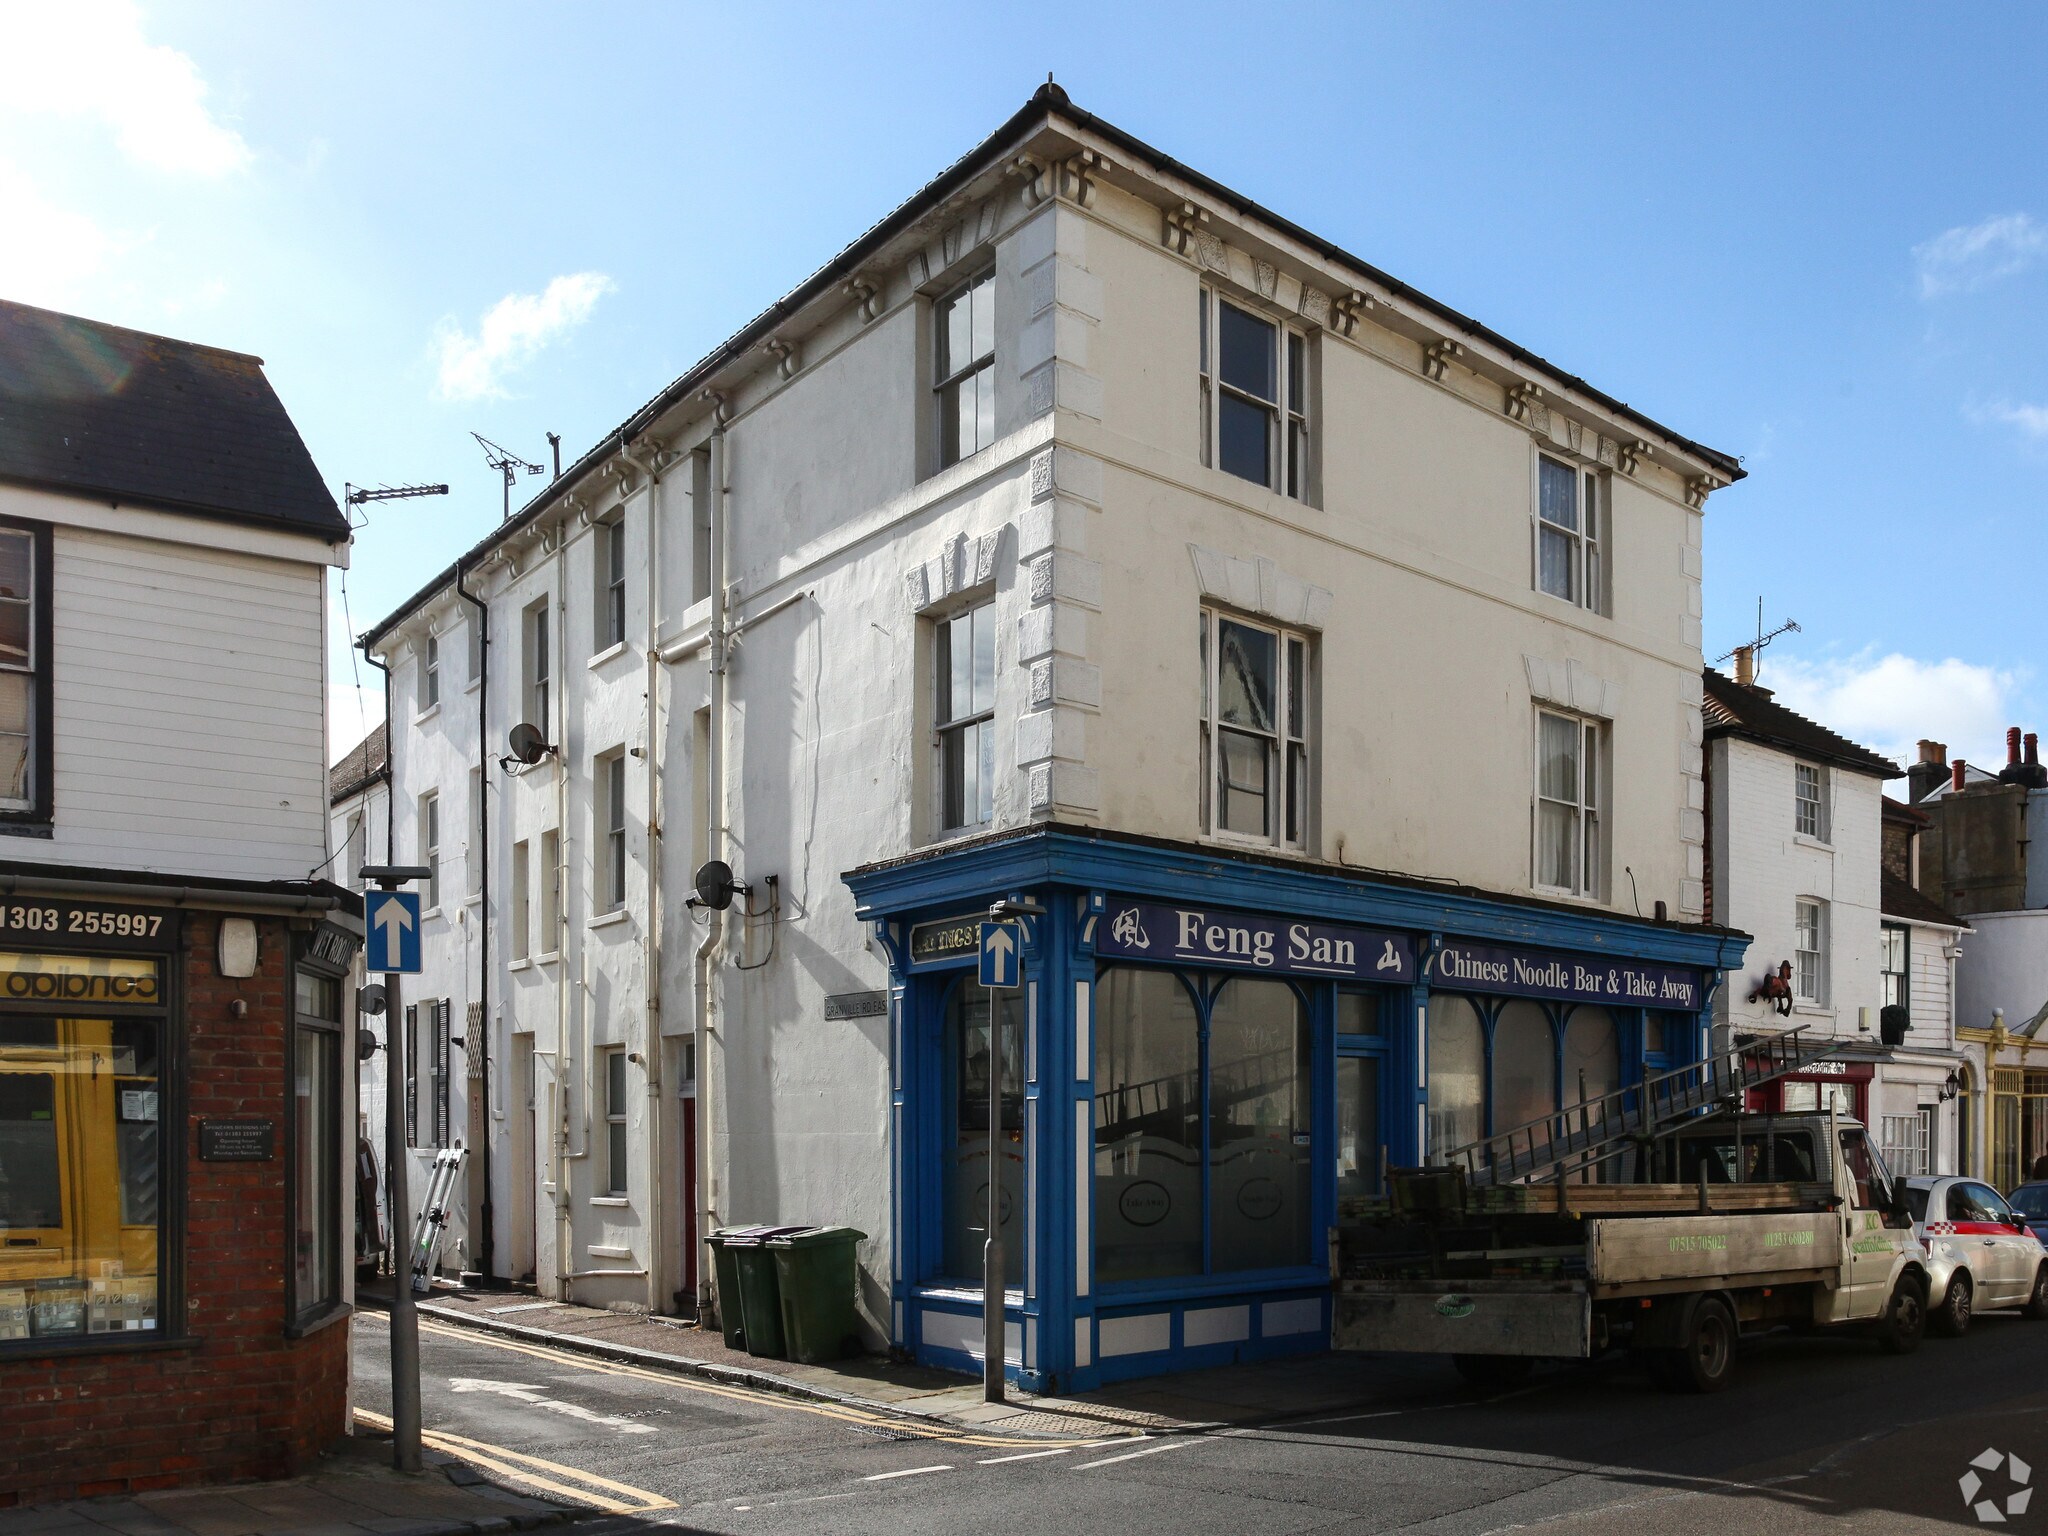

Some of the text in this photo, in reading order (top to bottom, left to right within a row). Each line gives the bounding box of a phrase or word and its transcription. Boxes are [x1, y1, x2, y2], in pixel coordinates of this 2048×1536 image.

[68, 910, 163, 937] 255997
[1175, 910, 1356, 966] Feng San
[1376, 939, 1402, 972] 山
[1440, 949, 1693, 1006] Chinese Noodle Bar & Take Away
[826, 999, 888, 1017] GRANVILLE RD EAS
[1865, 1213, 1879, 1230] KC
[1669, 1234, 1727, 1251] 07515 705022
[1764, 1232, 1787, 1247] 01233
[1852, 1235, 1893, 1254] scaffolding
